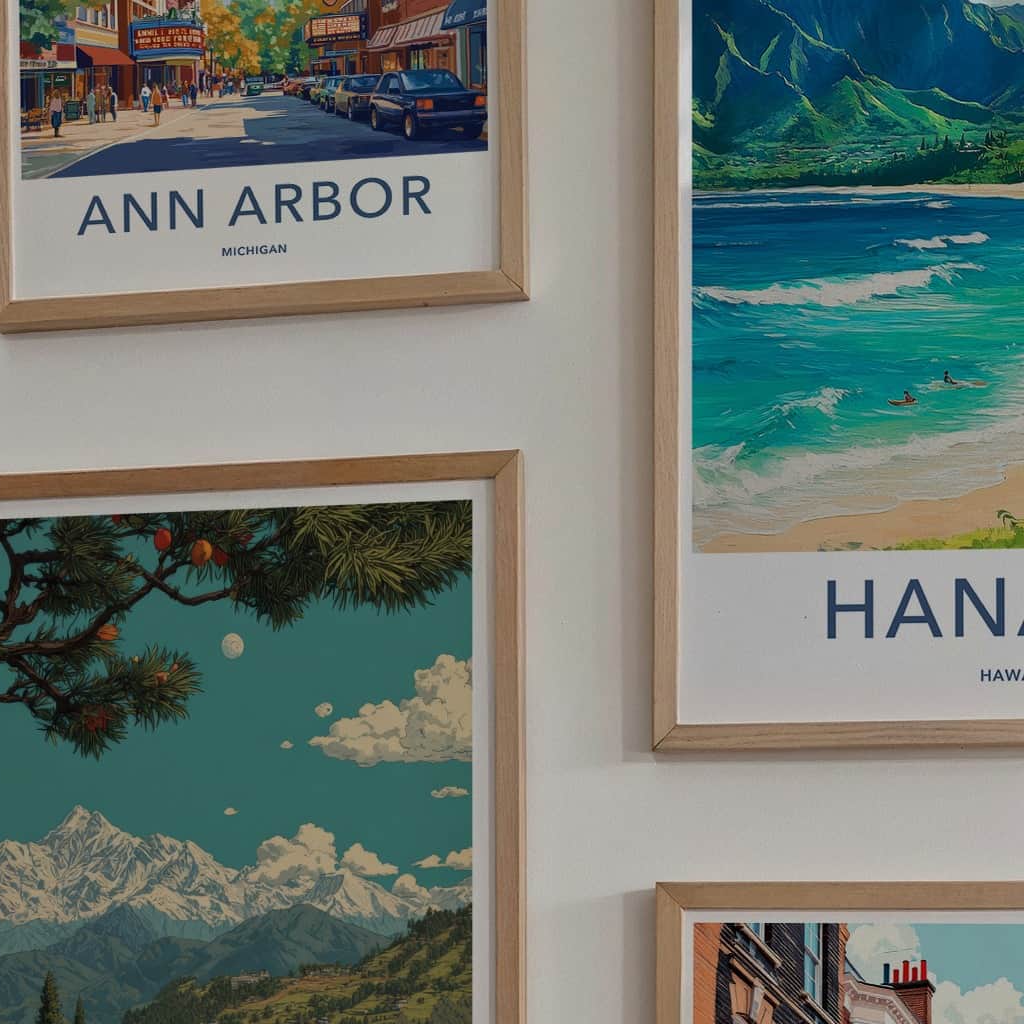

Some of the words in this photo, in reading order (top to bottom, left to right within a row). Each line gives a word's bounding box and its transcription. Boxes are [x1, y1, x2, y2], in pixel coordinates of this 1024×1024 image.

[77, 188, 204, 236] ANN
[228, 175, 432, 227] ARBOR
[221, 243, 288, 257] MICHIGAN
[826, 577, 1024, 640] HAN
[980, 668, 1024, 682] HAW
